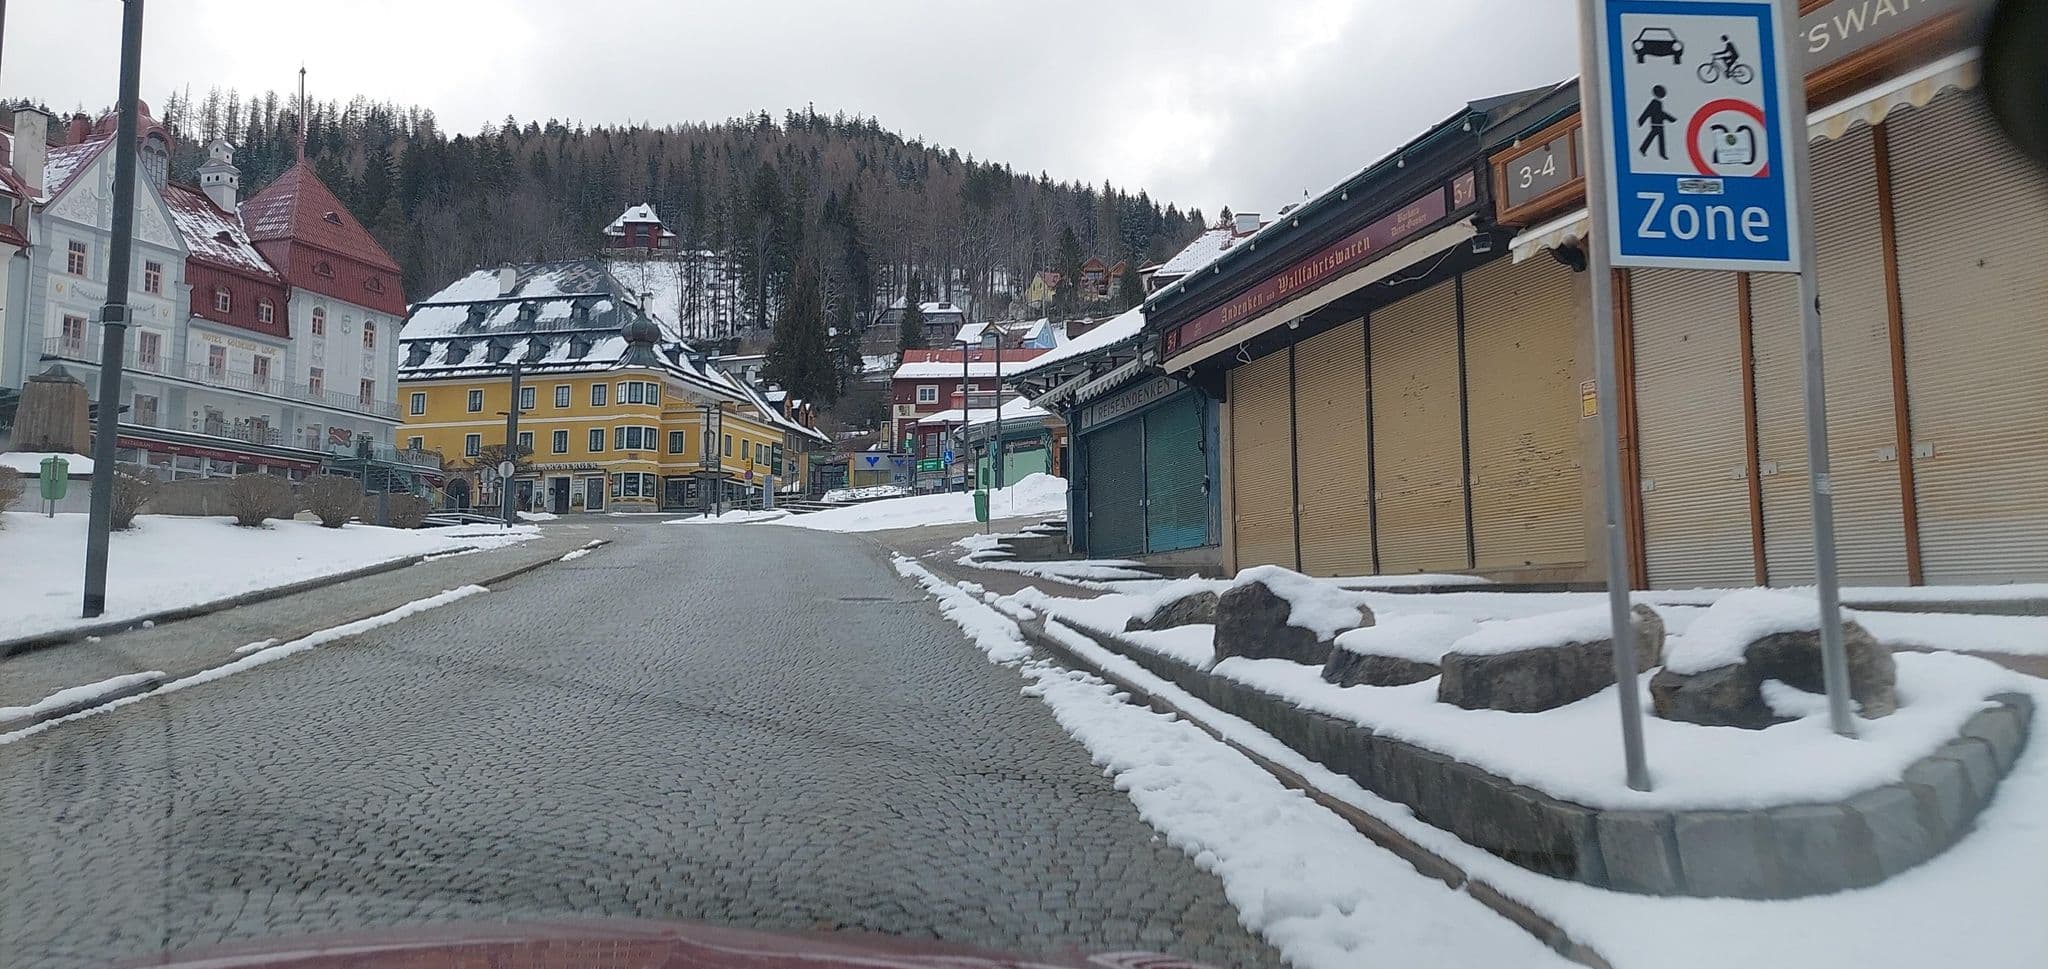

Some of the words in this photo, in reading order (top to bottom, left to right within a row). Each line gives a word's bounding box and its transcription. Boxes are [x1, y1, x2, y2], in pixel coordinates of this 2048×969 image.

[1519, 155, 1556, 188] 3-4
[1454, 176, 1474, 204] 5-7
[1637, 192, 1770, 242] Zone
[1221, 293, 1263, 323] Andenken
[1098, 379, 1170, 419] REISEANDENKEN
